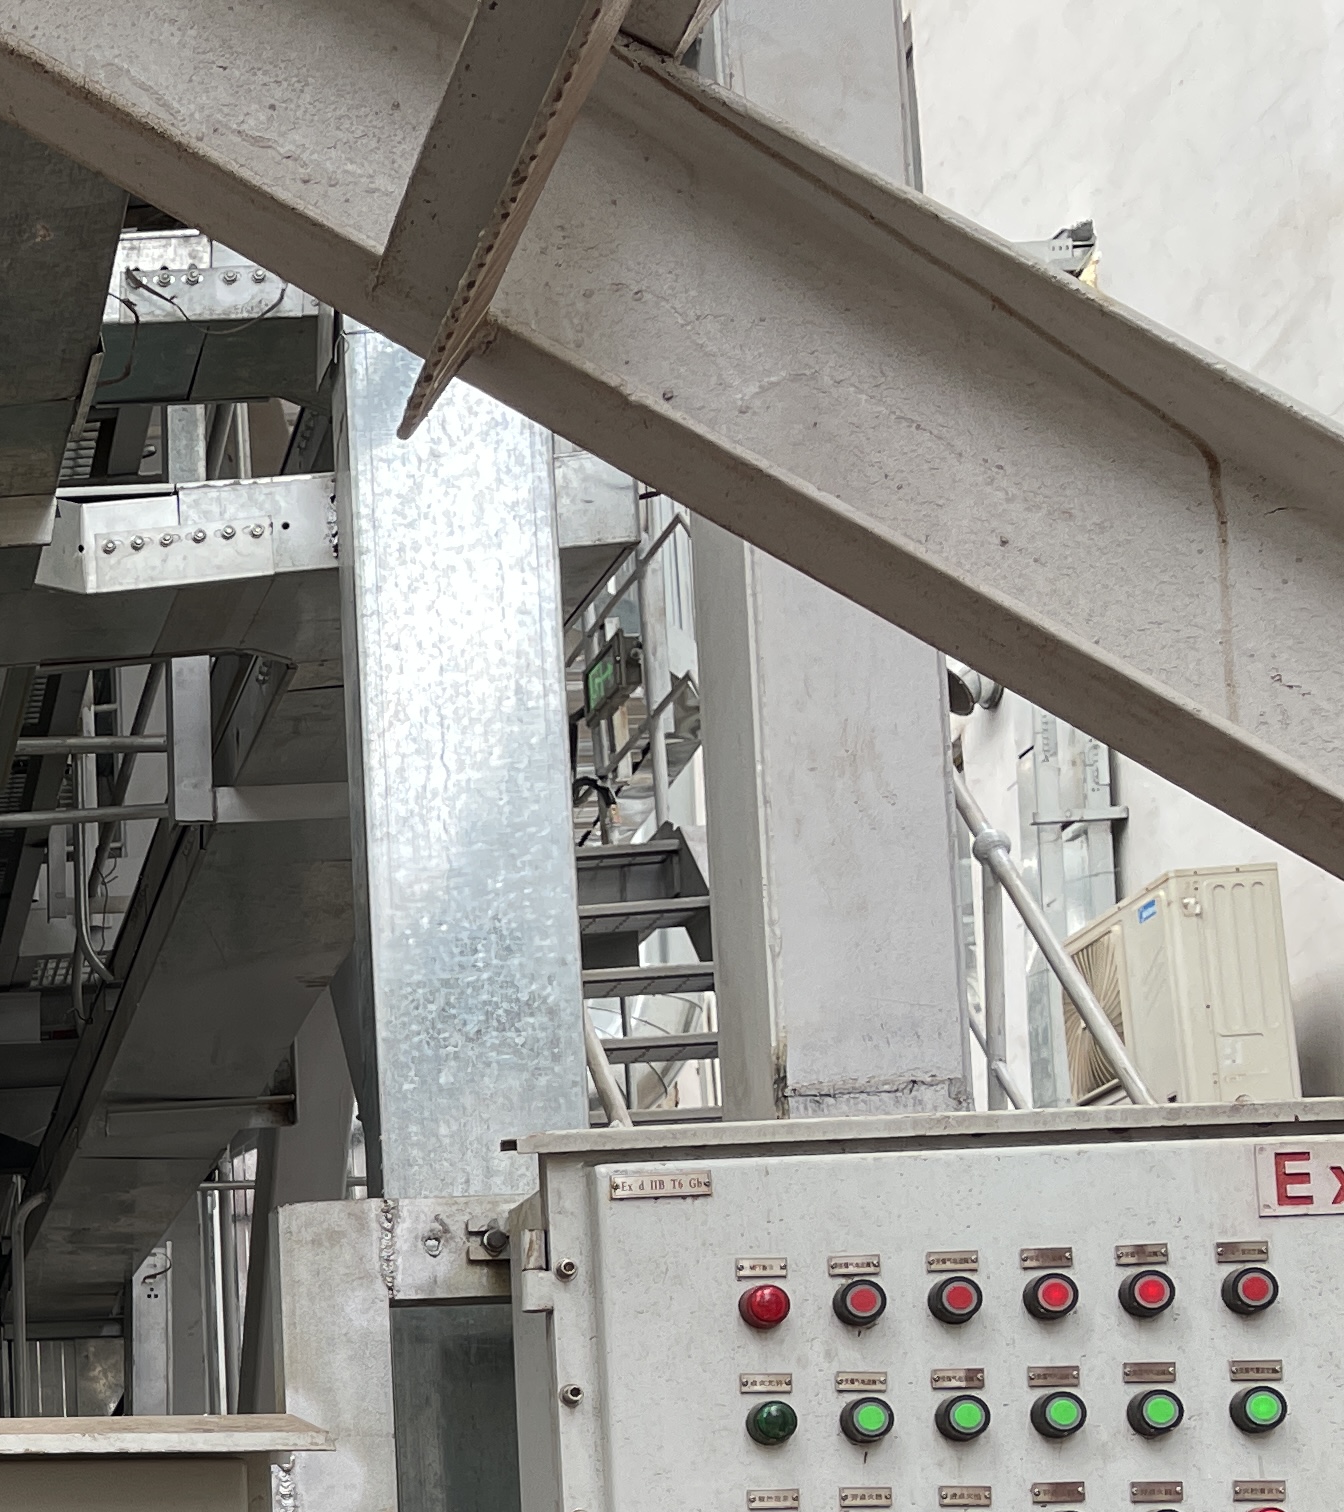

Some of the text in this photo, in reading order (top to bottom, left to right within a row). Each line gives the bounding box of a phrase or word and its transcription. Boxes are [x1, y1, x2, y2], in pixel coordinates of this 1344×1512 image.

[621, 1181, 634, 1192] Ex
[638, 1180, 645, 1191] d
[670, 1178, 684, 1189] T6
[689, 1177, 703, 1188] Gb
